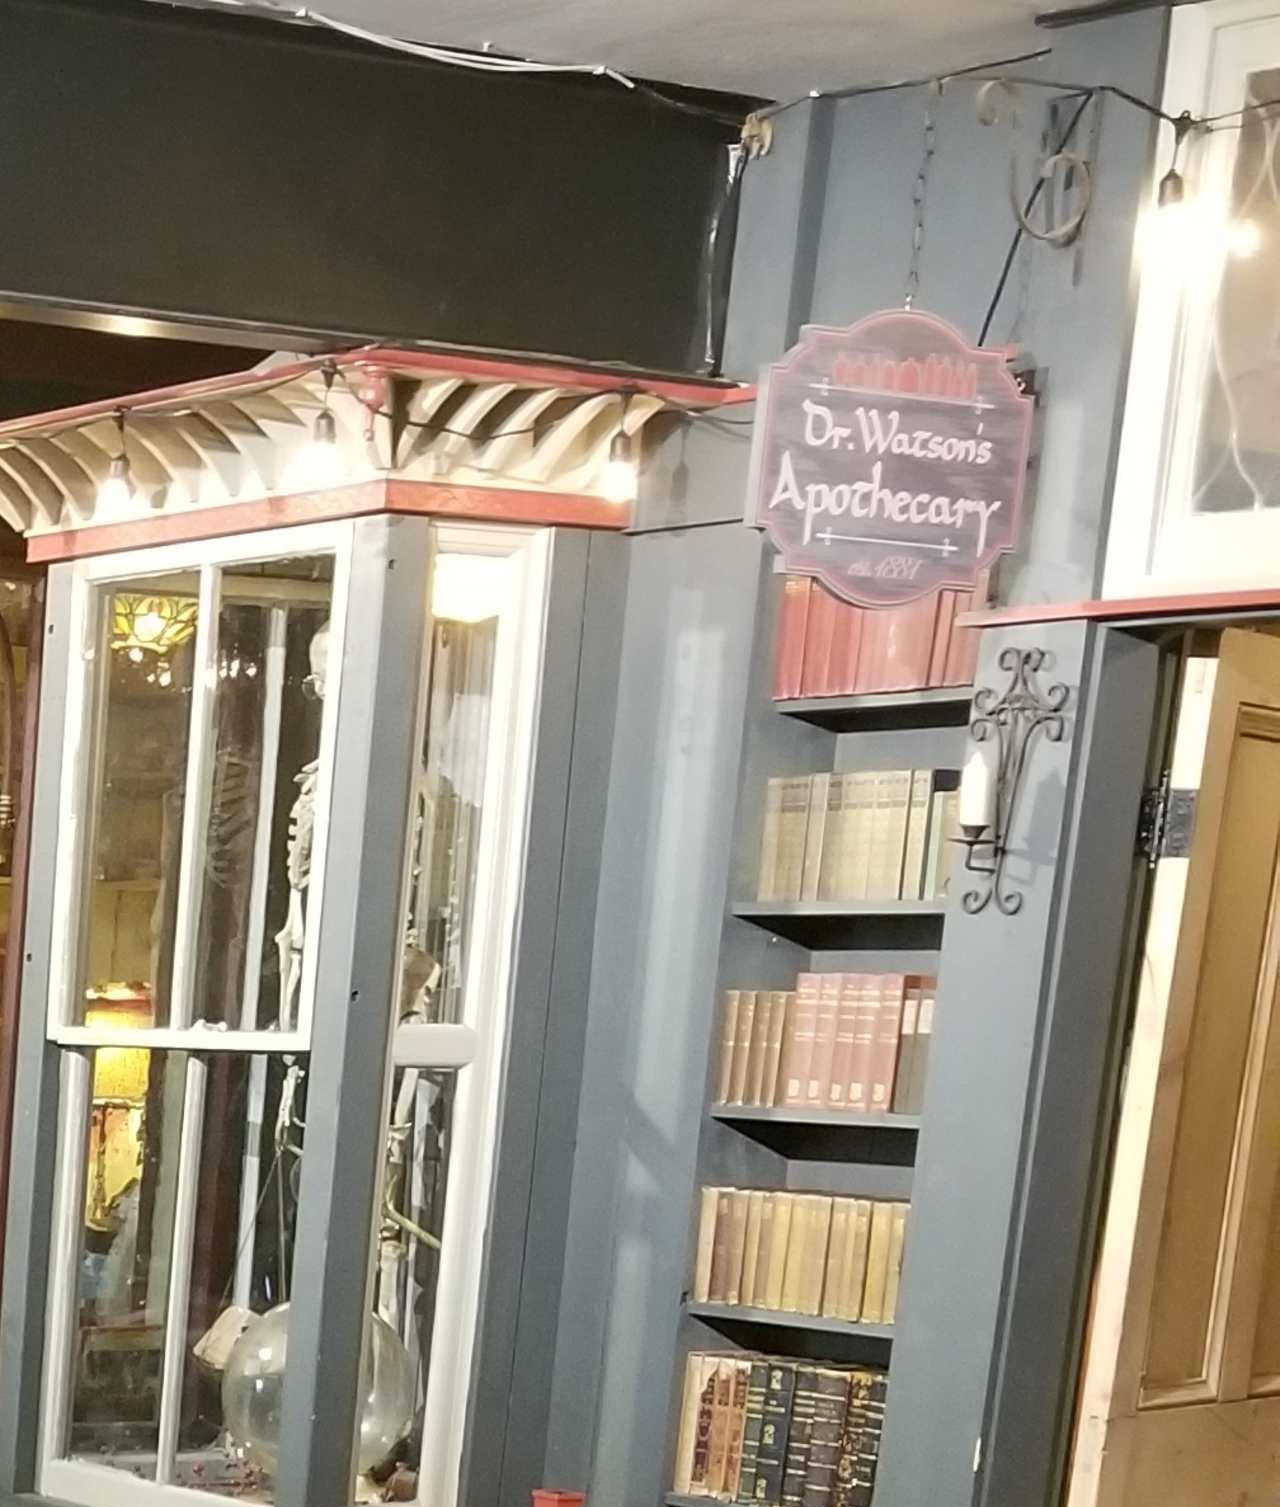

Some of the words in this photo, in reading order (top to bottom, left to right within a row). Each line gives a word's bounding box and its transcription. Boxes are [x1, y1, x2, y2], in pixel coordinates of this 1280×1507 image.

[802, 398, 855, 450] Dr.
[855, 406, 994, 464] Watson's
[768, 449, 1003, 558] Apothecary
